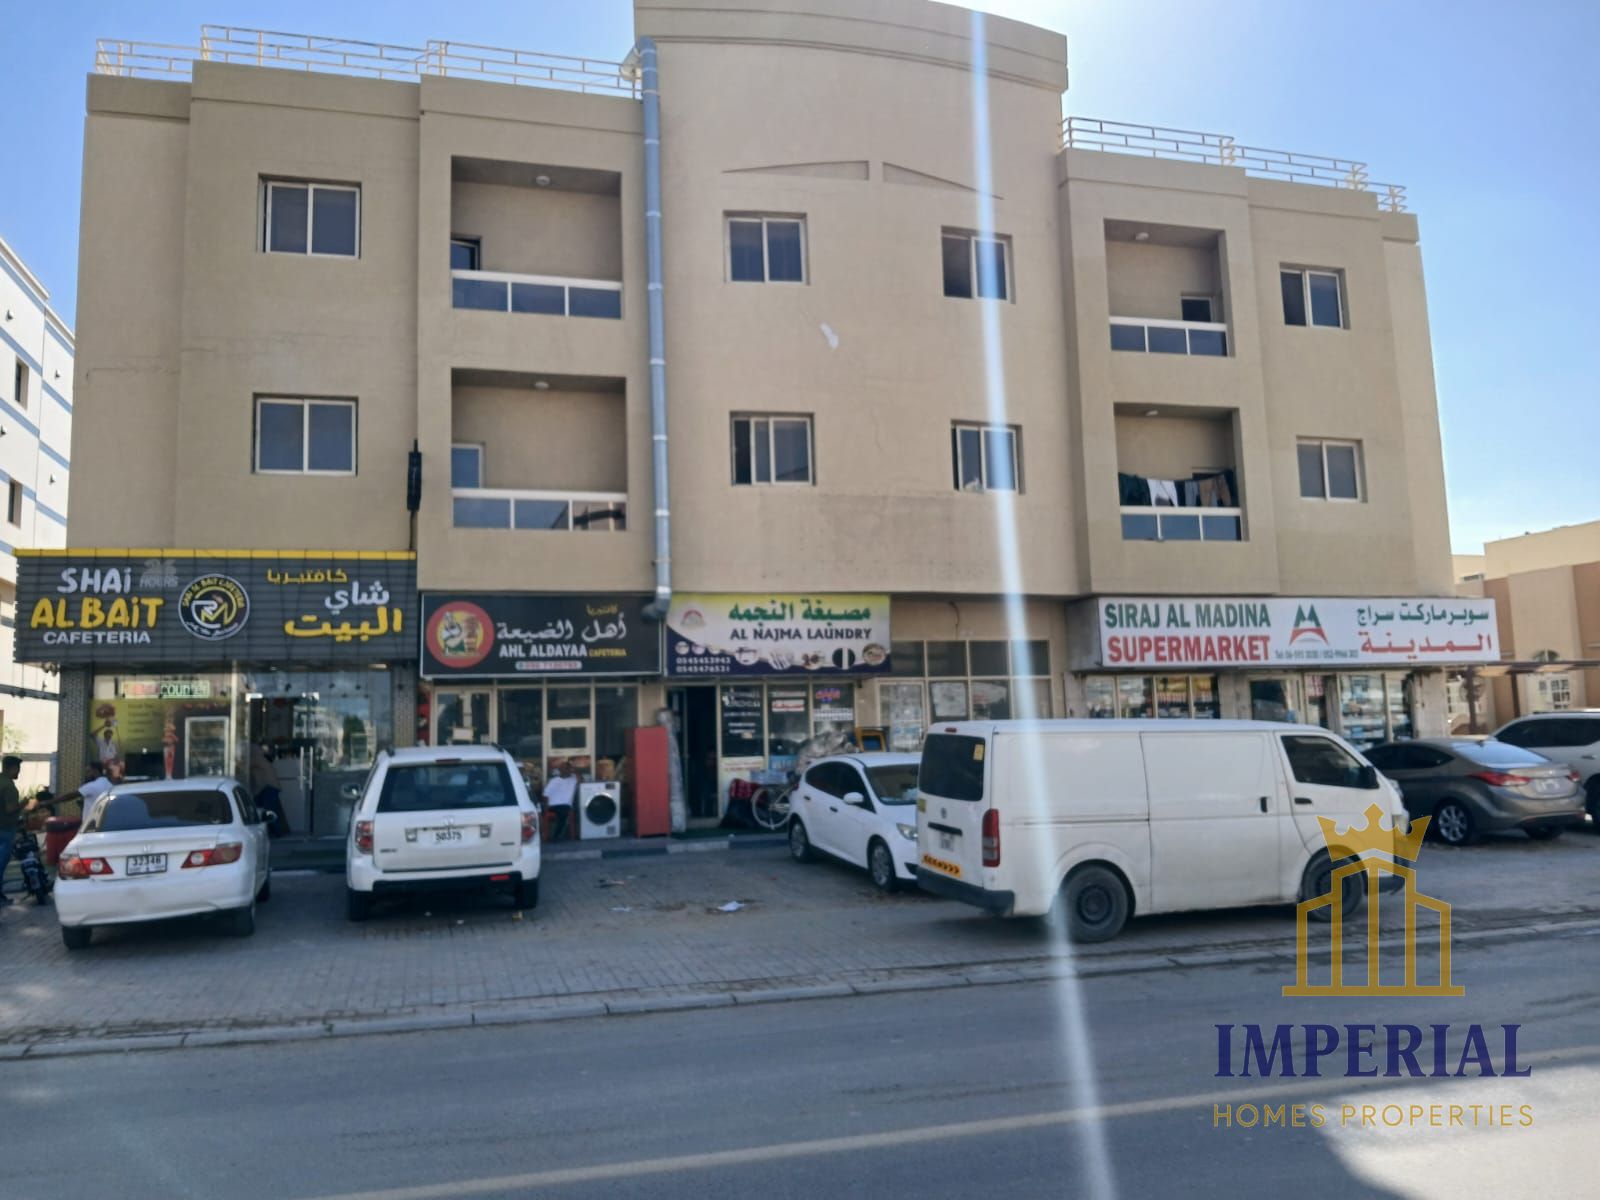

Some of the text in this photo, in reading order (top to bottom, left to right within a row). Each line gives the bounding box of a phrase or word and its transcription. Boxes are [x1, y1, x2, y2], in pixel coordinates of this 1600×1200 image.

[324, 580, 390, 615] شاي
[284, 605, 402, 642] البيت
[802, 598, 871, 627] مصبغة
[1104, 602, 1272, 629] SIRAJ AL MADINA
[1356, 604, 1395, 627] سراج
[42, 631, 151, 645] CAFETERIA
[496, 612, 627, 644] أهل الضيعة
[730, 628, 873, 642] AL NAJMA LAUNDRY
[498, 644, 526, 658] AHL
[529, 644, 588, 658] ALDAYAA
[1107, 635, 1271, 662] SUPERMARKET
[1358, 631, 1492, 660] المدينة
